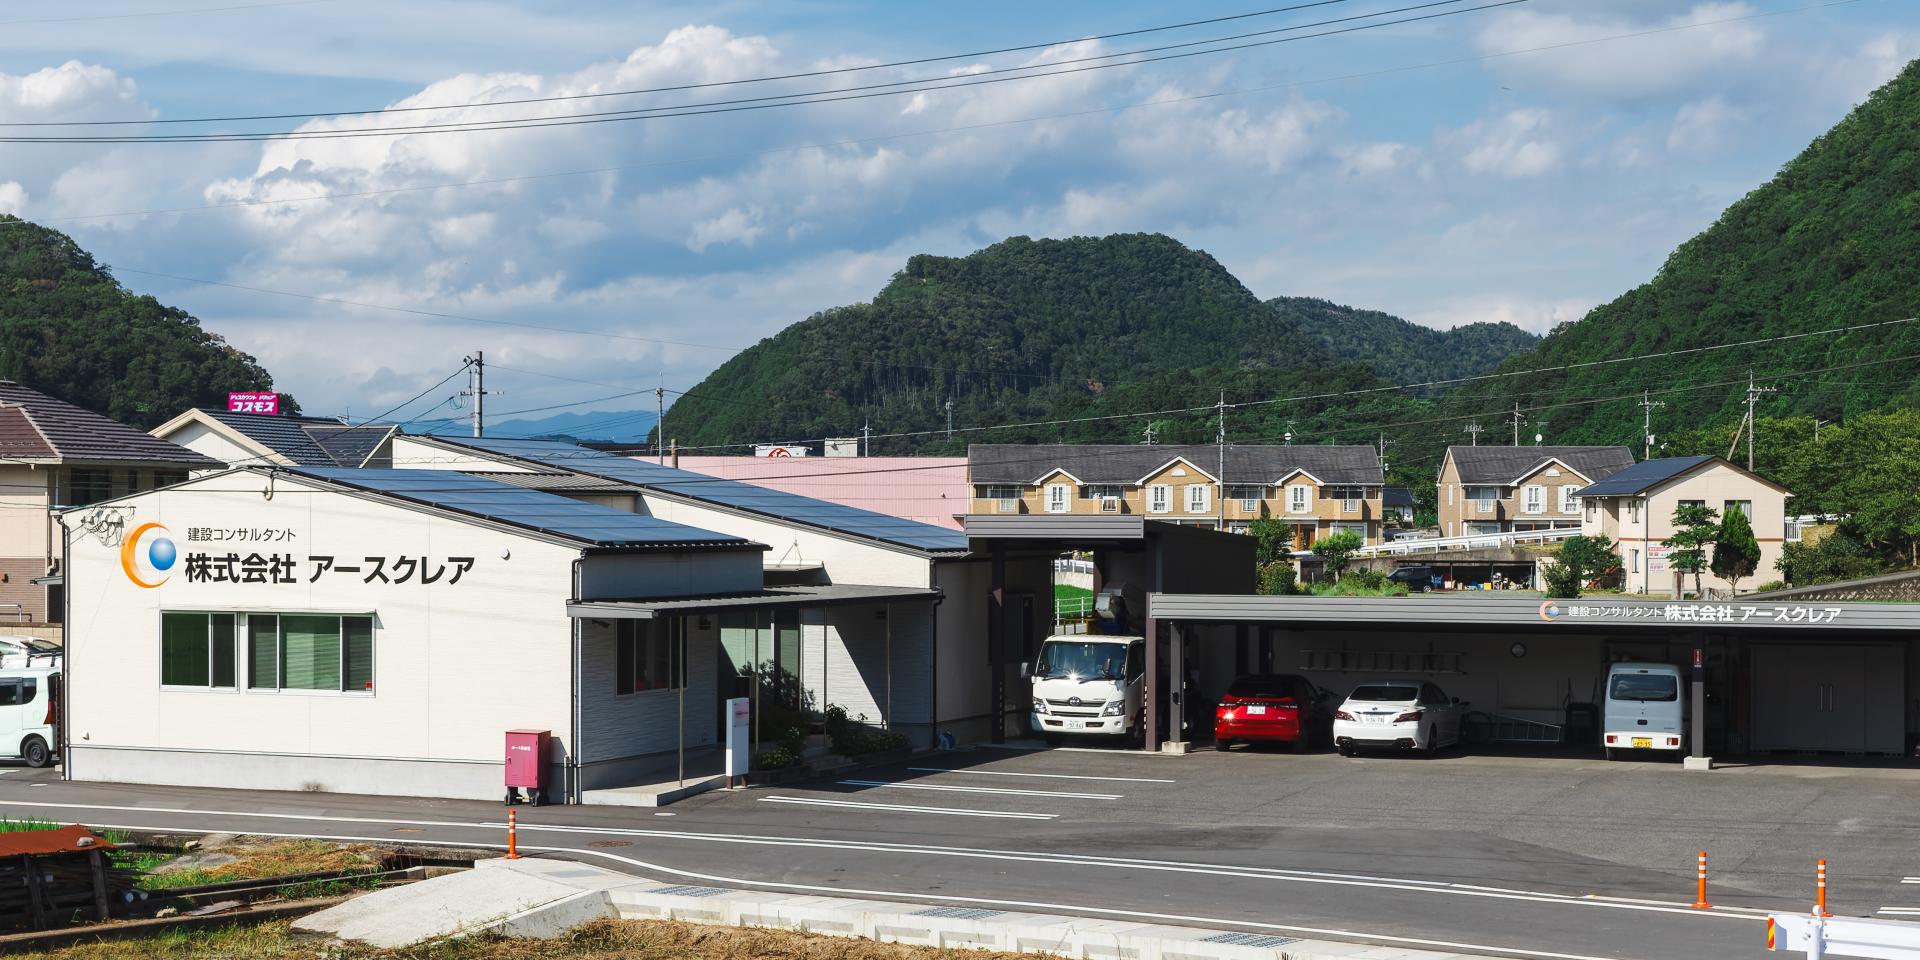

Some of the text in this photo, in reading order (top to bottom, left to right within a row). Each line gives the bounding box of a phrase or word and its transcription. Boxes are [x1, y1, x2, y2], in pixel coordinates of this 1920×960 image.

[231, 401, 275, 412] コスモス
[187, 527, 297, 543] 建設コンサルタント
[185, 552, 475, 585] 株式会社 アースクレア
[1567, 604, 1842, 623] 建設コンサルタント 株式会社 アースクレア
